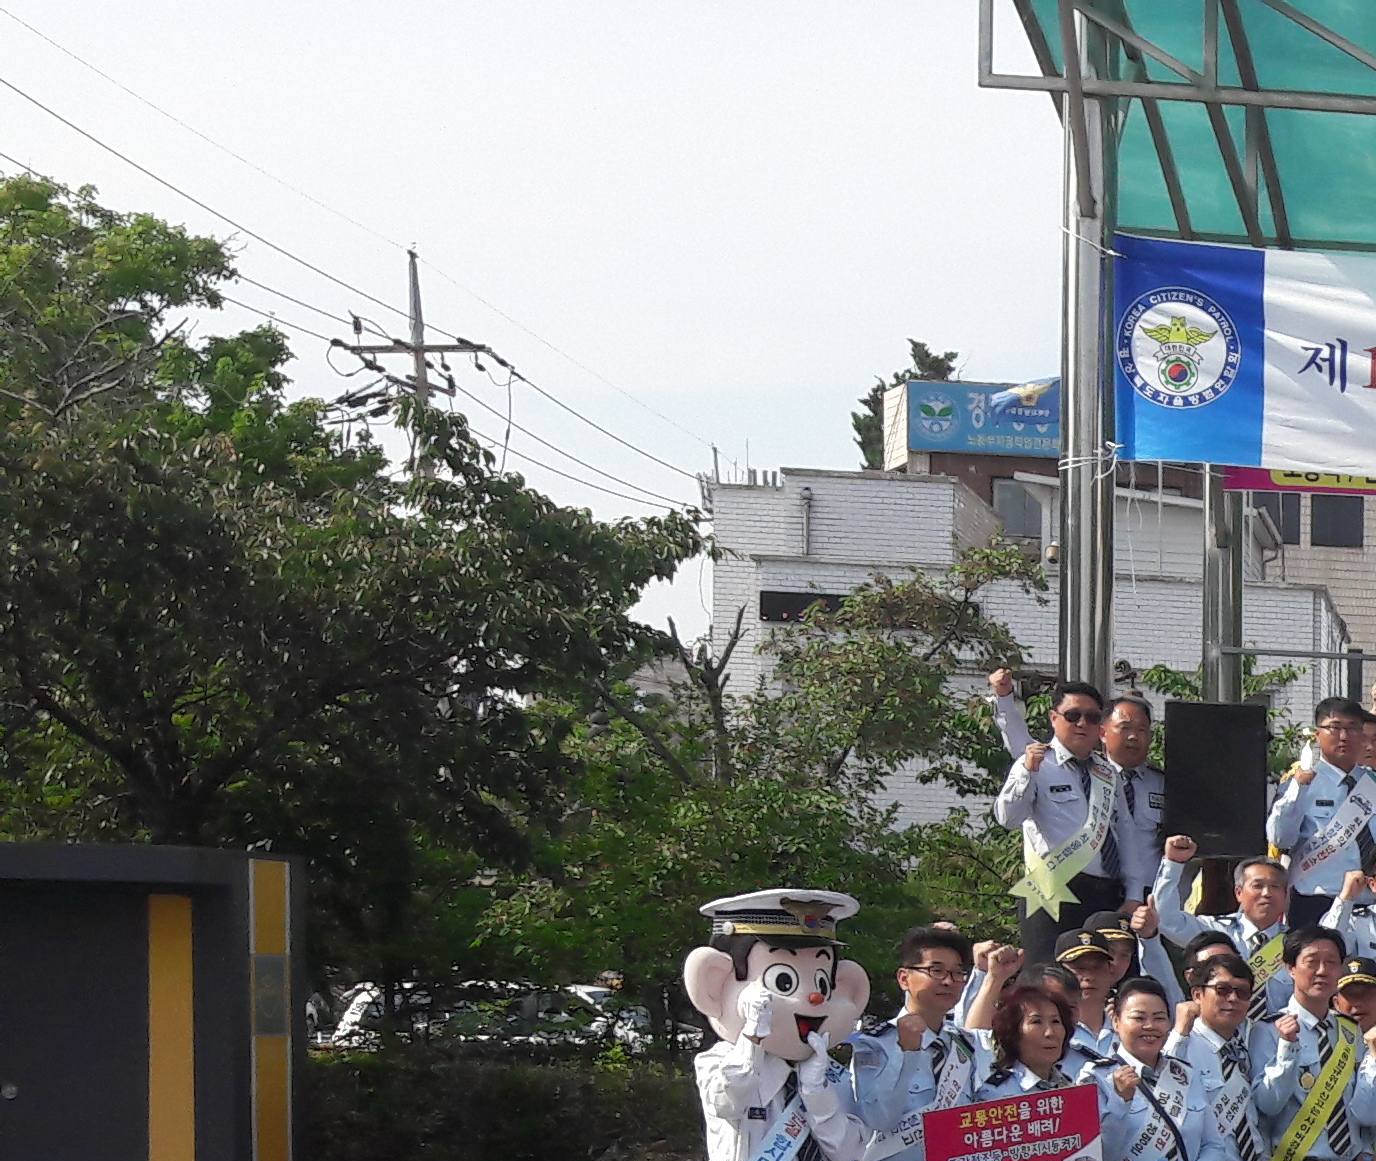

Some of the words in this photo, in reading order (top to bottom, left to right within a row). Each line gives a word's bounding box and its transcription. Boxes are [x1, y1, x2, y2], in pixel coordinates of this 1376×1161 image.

[1123, 303, 1147, 337] KOREA
[1150, 291, 1204, 307] CITIZEN'S
[1207, 305, 1234, 342] PATROL
[959, 1102, 1032, 1129] 교통안전을
[1036, 1095, 1064, 1115] 위한
[964, 1122, 1023, 1149] 아름다운
[1027, 1118, 1062, 1137] 배려!
